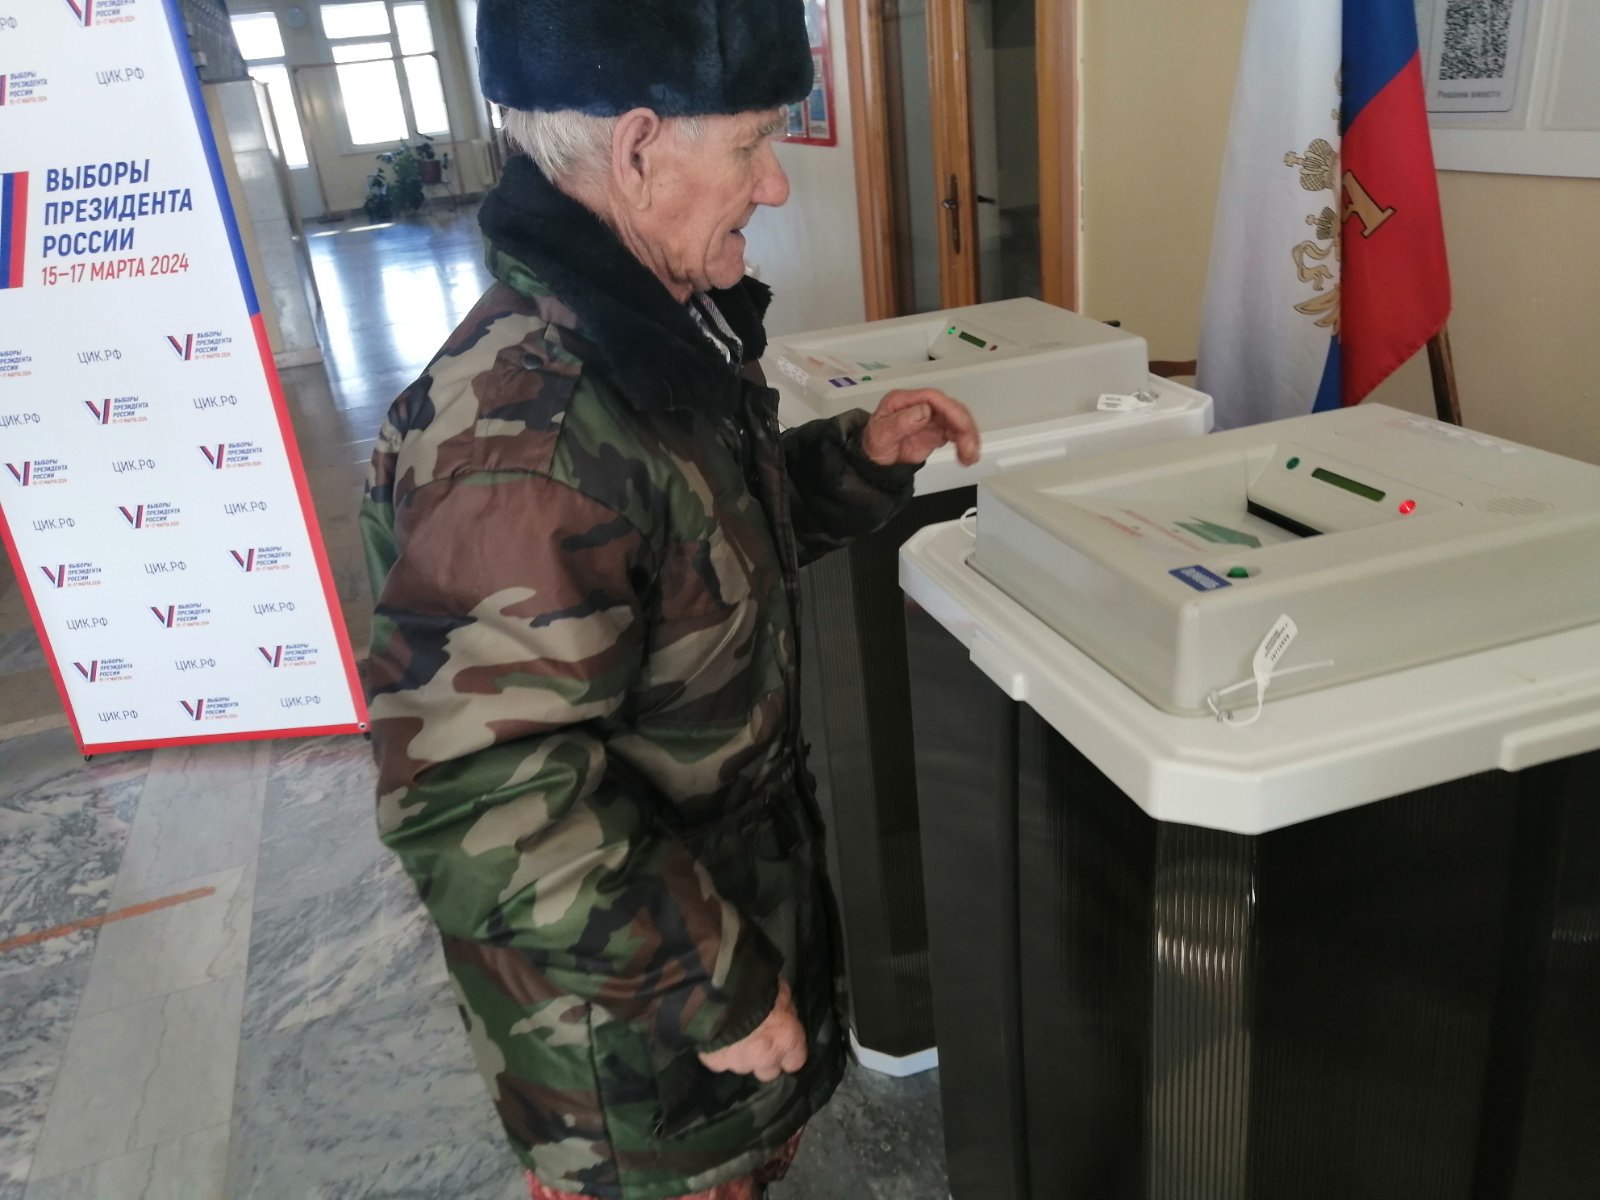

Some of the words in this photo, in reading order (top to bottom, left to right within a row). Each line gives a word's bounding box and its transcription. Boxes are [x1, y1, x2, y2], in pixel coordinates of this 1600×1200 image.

[96, 68, 144, 86] ЦИК.РФ
[46, 159, 150, 192] ВЫБОРЫ
[45, 189, 192, 226] ПРЕЗИДЕНТА
[42, 227, 134, 258] РОССИИ
[91, 258, 145, 282] МАРТА
[150, 253, 189, 276] 2024
[78, 350, 122, 365] ЦИК.РФ
[194, 395, 238, 410] ЦИК.РФ
[112, 459, 156, 474] ЦИК.РФ
[225, 501, 267, 515] ЦИК.РФ
[33, 517, 75, 533] ЦИК.РФ
[145, 561, 187, 575] ЦИК.РФ
[253, 602, 295, 616] ЦИК.РФ
[67, 617, 108, 632] ЦИК.РФ
[176, 659, 216, 672] ЦИК.РФ
[281, 696, 321, 709] ЦИК.РФ
[99, 711, 139, 723] ЦИК.РФ
